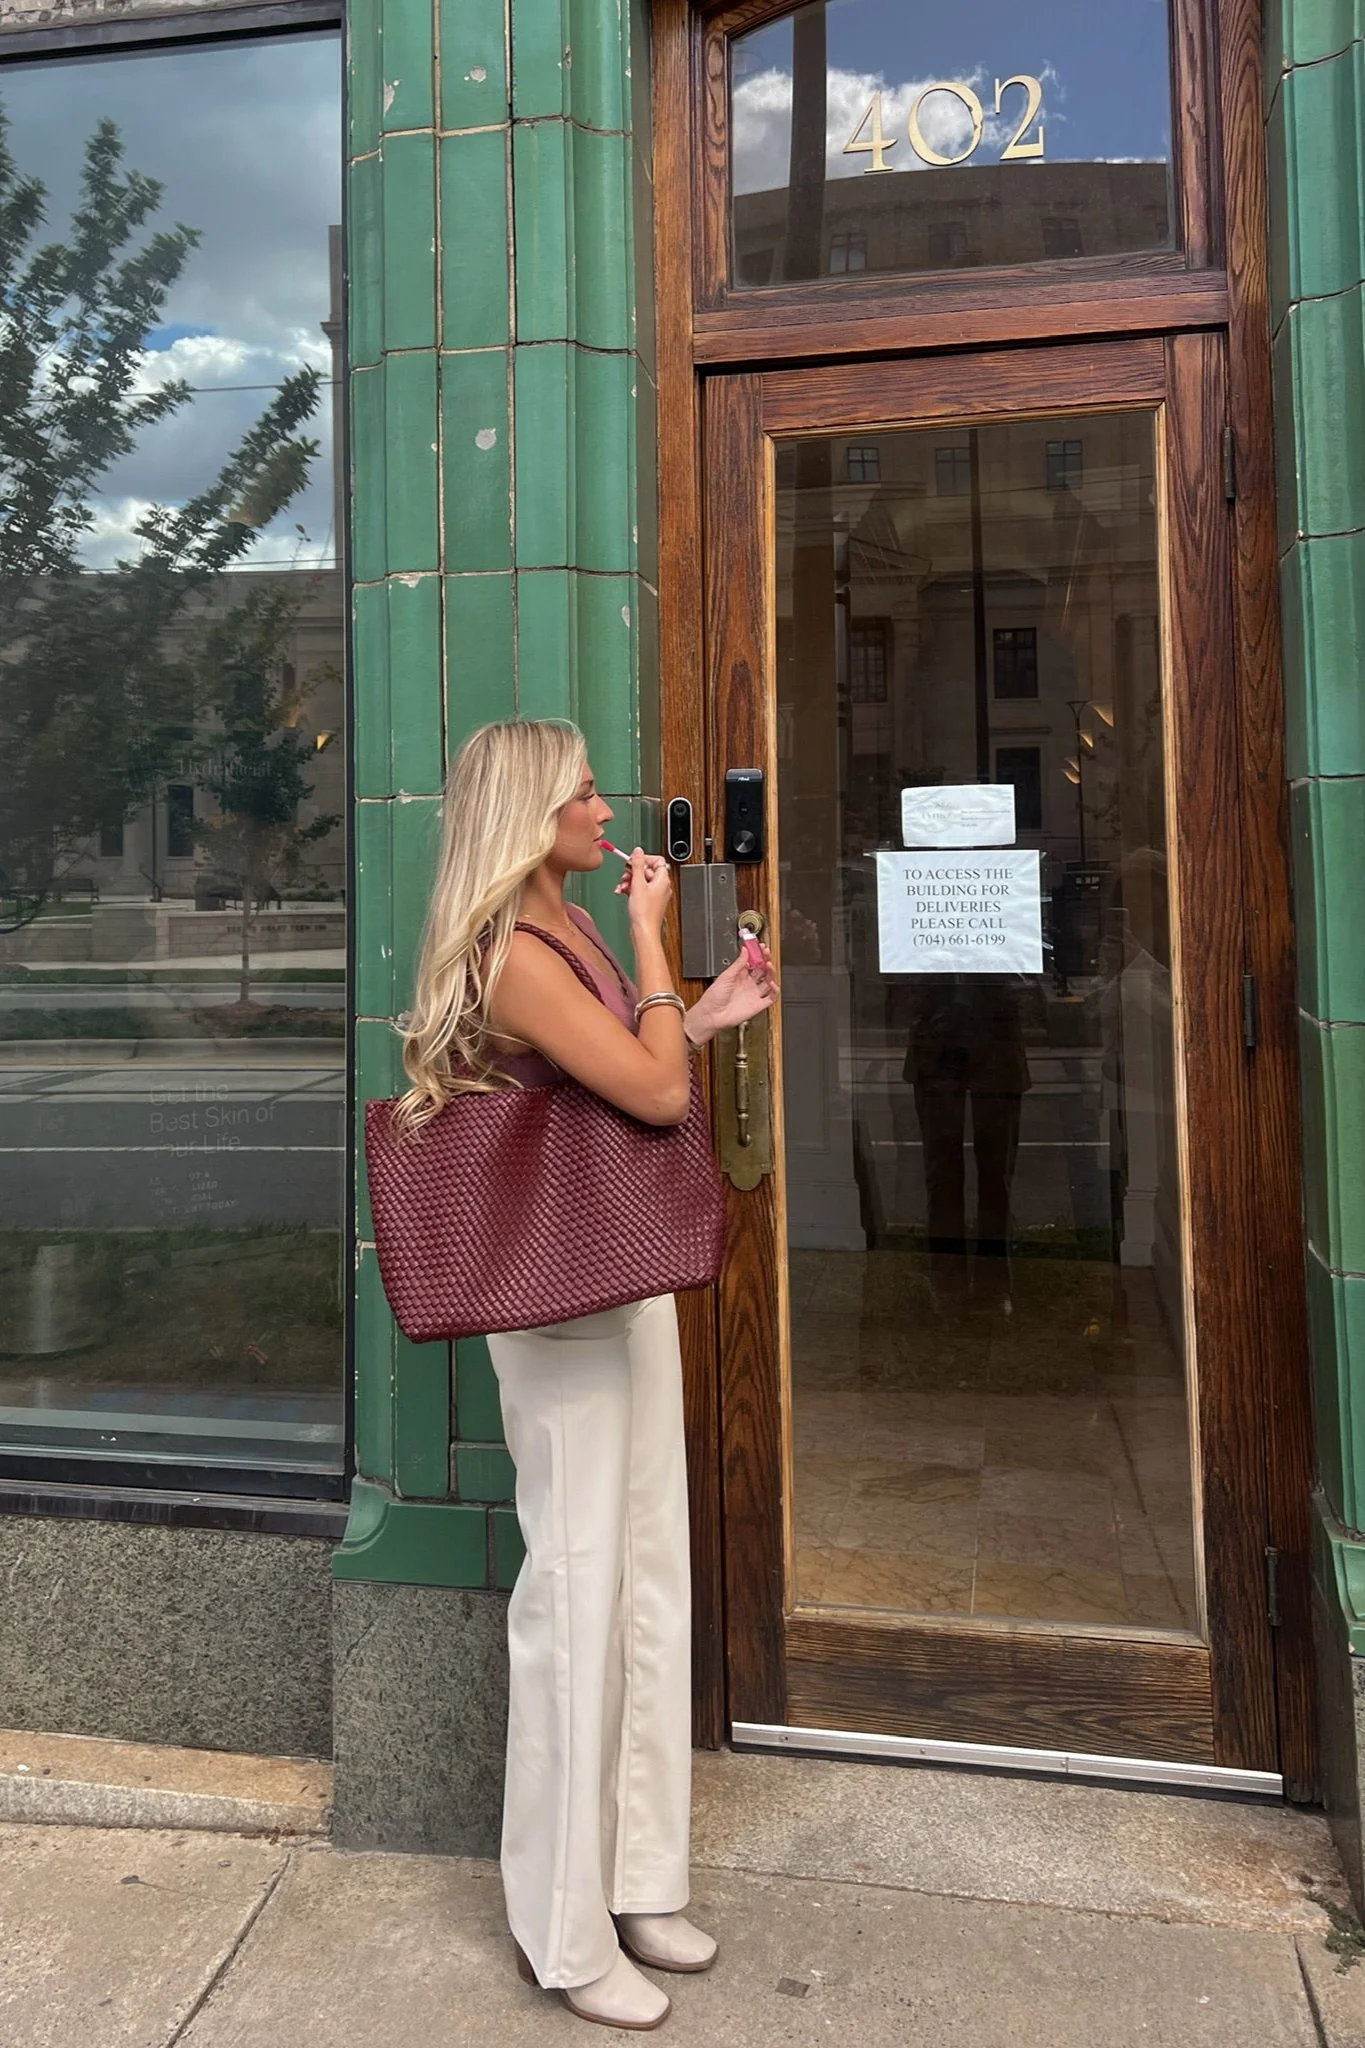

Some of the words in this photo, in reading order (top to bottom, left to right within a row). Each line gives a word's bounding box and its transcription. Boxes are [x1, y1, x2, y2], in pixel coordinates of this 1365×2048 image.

[842, 75, 1046, 174] 402
[903, 869, 922, 880] TO
[925, 868, 980, 880] ACCESS
[984, 868, 1013, 880] THE
[906, 885, 977, 896] BUILDING
[981, 884, 1010, 896] FOR
[916, 901, 1001, 913] DELIVERIES
[911, 918, 964, 929] PLEASE
[968, 918, 1007, 929] CALL
[913, 933, 945, 947] (704)
[948, 933, 1006, 945] 661-6199
[195, 1080, 229, 1102] the
[150, 1110, 199, 1133] Best
[205, 1104, 249, 1128] Skin
[255, 1101, 277, 1123] of
[203, 1131, 241, 1154] Life
